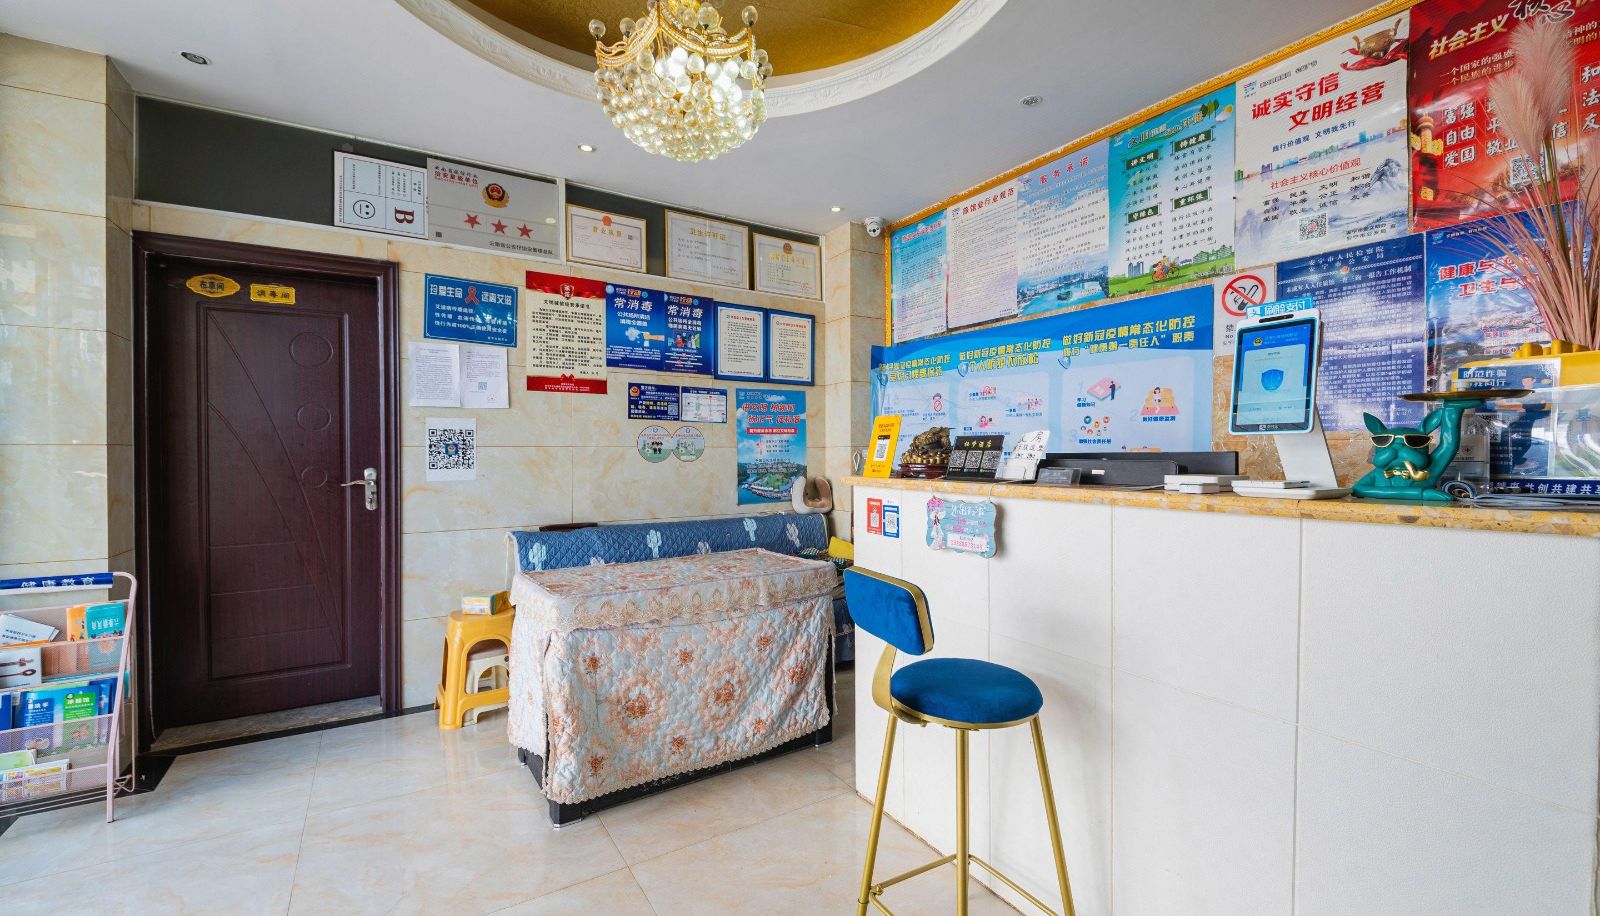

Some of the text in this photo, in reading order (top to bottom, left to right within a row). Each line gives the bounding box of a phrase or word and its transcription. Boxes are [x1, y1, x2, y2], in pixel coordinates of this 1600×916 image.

[1429, 14, 1509, 59] 社会主义
[1251, 72, 1340, 120] 诚实守信
[1288, 80, 1386, 131] 文明经营
[1443, 103, 1475, 125] 富强
[1445, 126, 1475, 146] 自由
[1444, 146, 1475, 168] 爱国
[1270, 157, 1361, 191] 社会主义核心价值观
[614, 297, 653, 312] 常消毒
[1062, 315, 1196, 346] 做好新冠疫情常态化防控
